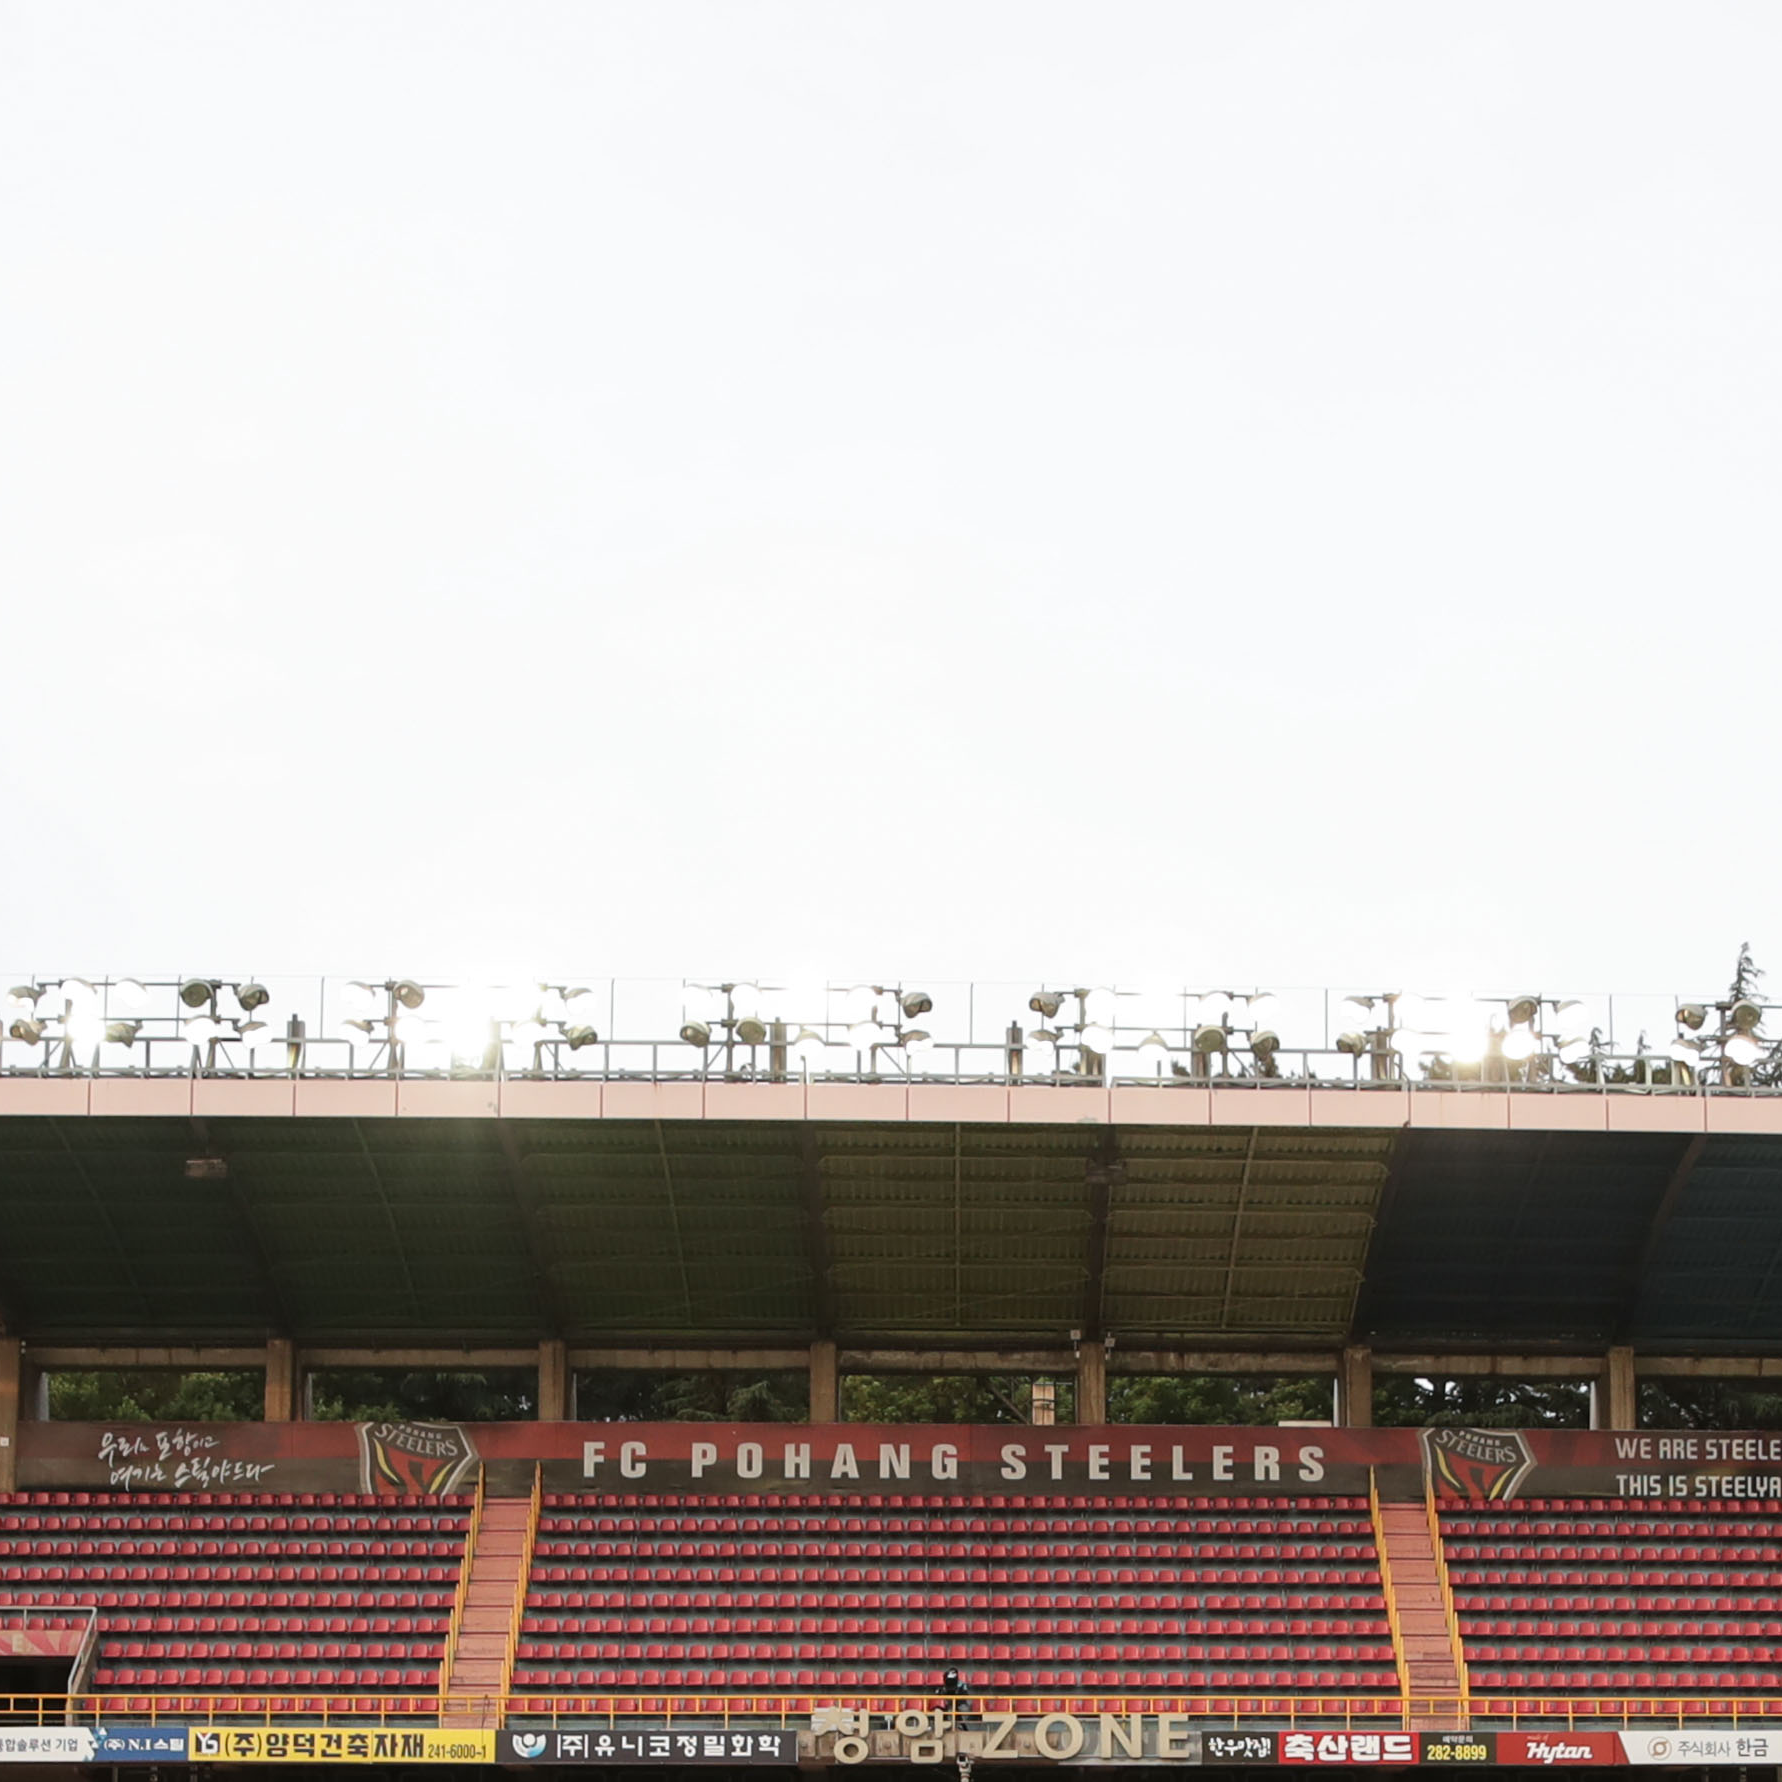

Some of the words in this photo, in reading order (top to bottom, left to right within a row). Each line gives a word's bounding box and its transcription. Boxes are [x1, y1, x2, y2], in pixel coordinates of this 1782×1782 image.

[373, 1422, 458, 1457] STEELERS
[1435, 1430, 1517, 1463] STEELERS
[1615, 1438, 1651, 1460] WE
[1659, 1438, 1698, 1460] ARE
[583, 1441, 647, 1478] FC
[691, 1443, 958, 1480] POHANG
[1000, 1444, 1324, 1481] STEELERS
[1616, 1474, 1661, 1497] THIS
[1669, 1475, 1687, 1497] IS
[55, 1738, 79, 1754] 기업
[225, 1732, 424, 1759] (주)양덕건축자재
[428, 1744, 487, 1760] 241-6000-1
[981, 1712, 1190, 1761] ZONE
[1207, 1737, 1271, 1758] 한우맛집!
[1284, 1734, 1413, 1762] 축산랜드
[1677, 1740, 1731, 1758] 주식회사
[1736, 1738, 1769, 1758] 한금
[1427, 1744, 1487, 1761] 282-8899
[1526, 1742, 1593, 1764] Hytan
